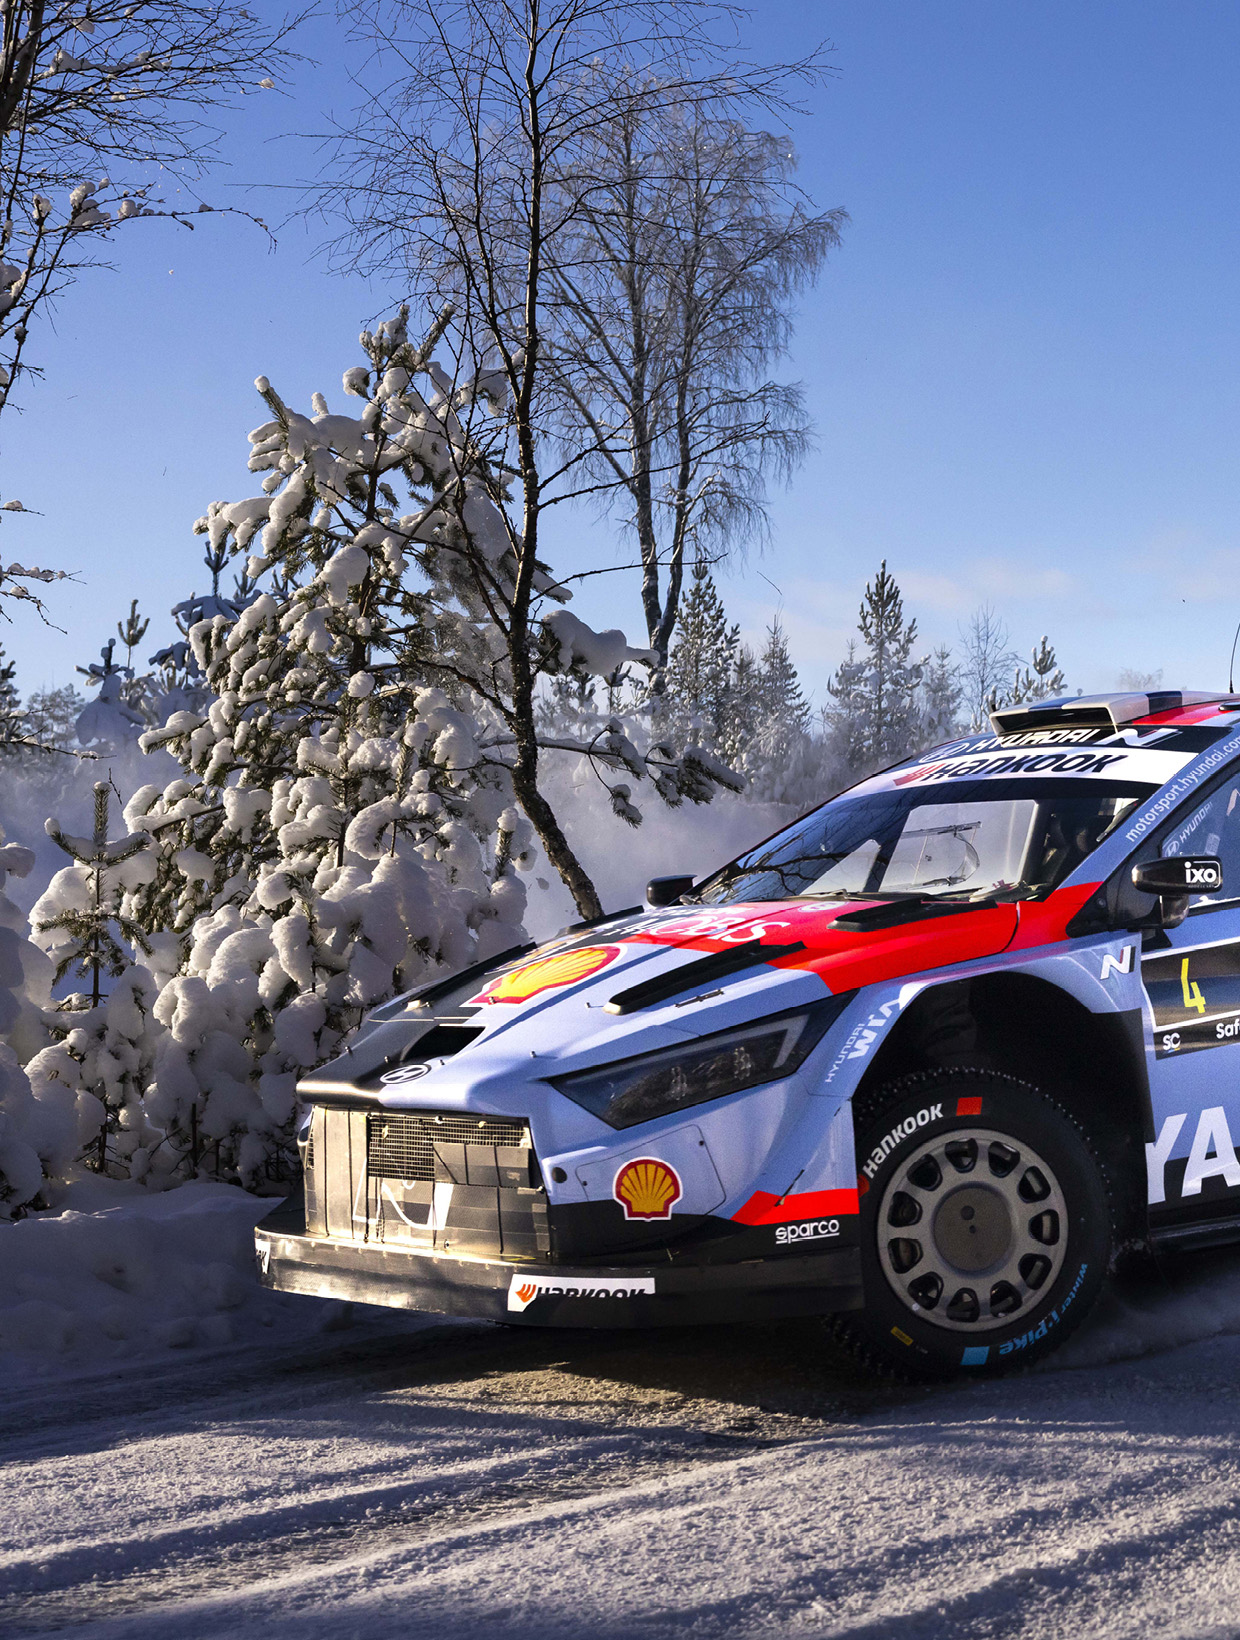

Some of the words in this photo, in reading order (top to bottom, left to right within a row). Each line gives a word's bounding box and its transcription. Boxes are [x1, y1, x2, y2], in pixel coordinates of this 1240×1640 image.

[1181, 958, 1206, 1014] 4
[824, 1023, 865, 1082] HYUNDAI
[1162, 1032, 1181, 1051] SC
[775, 1219, 840, 1244] sparco
